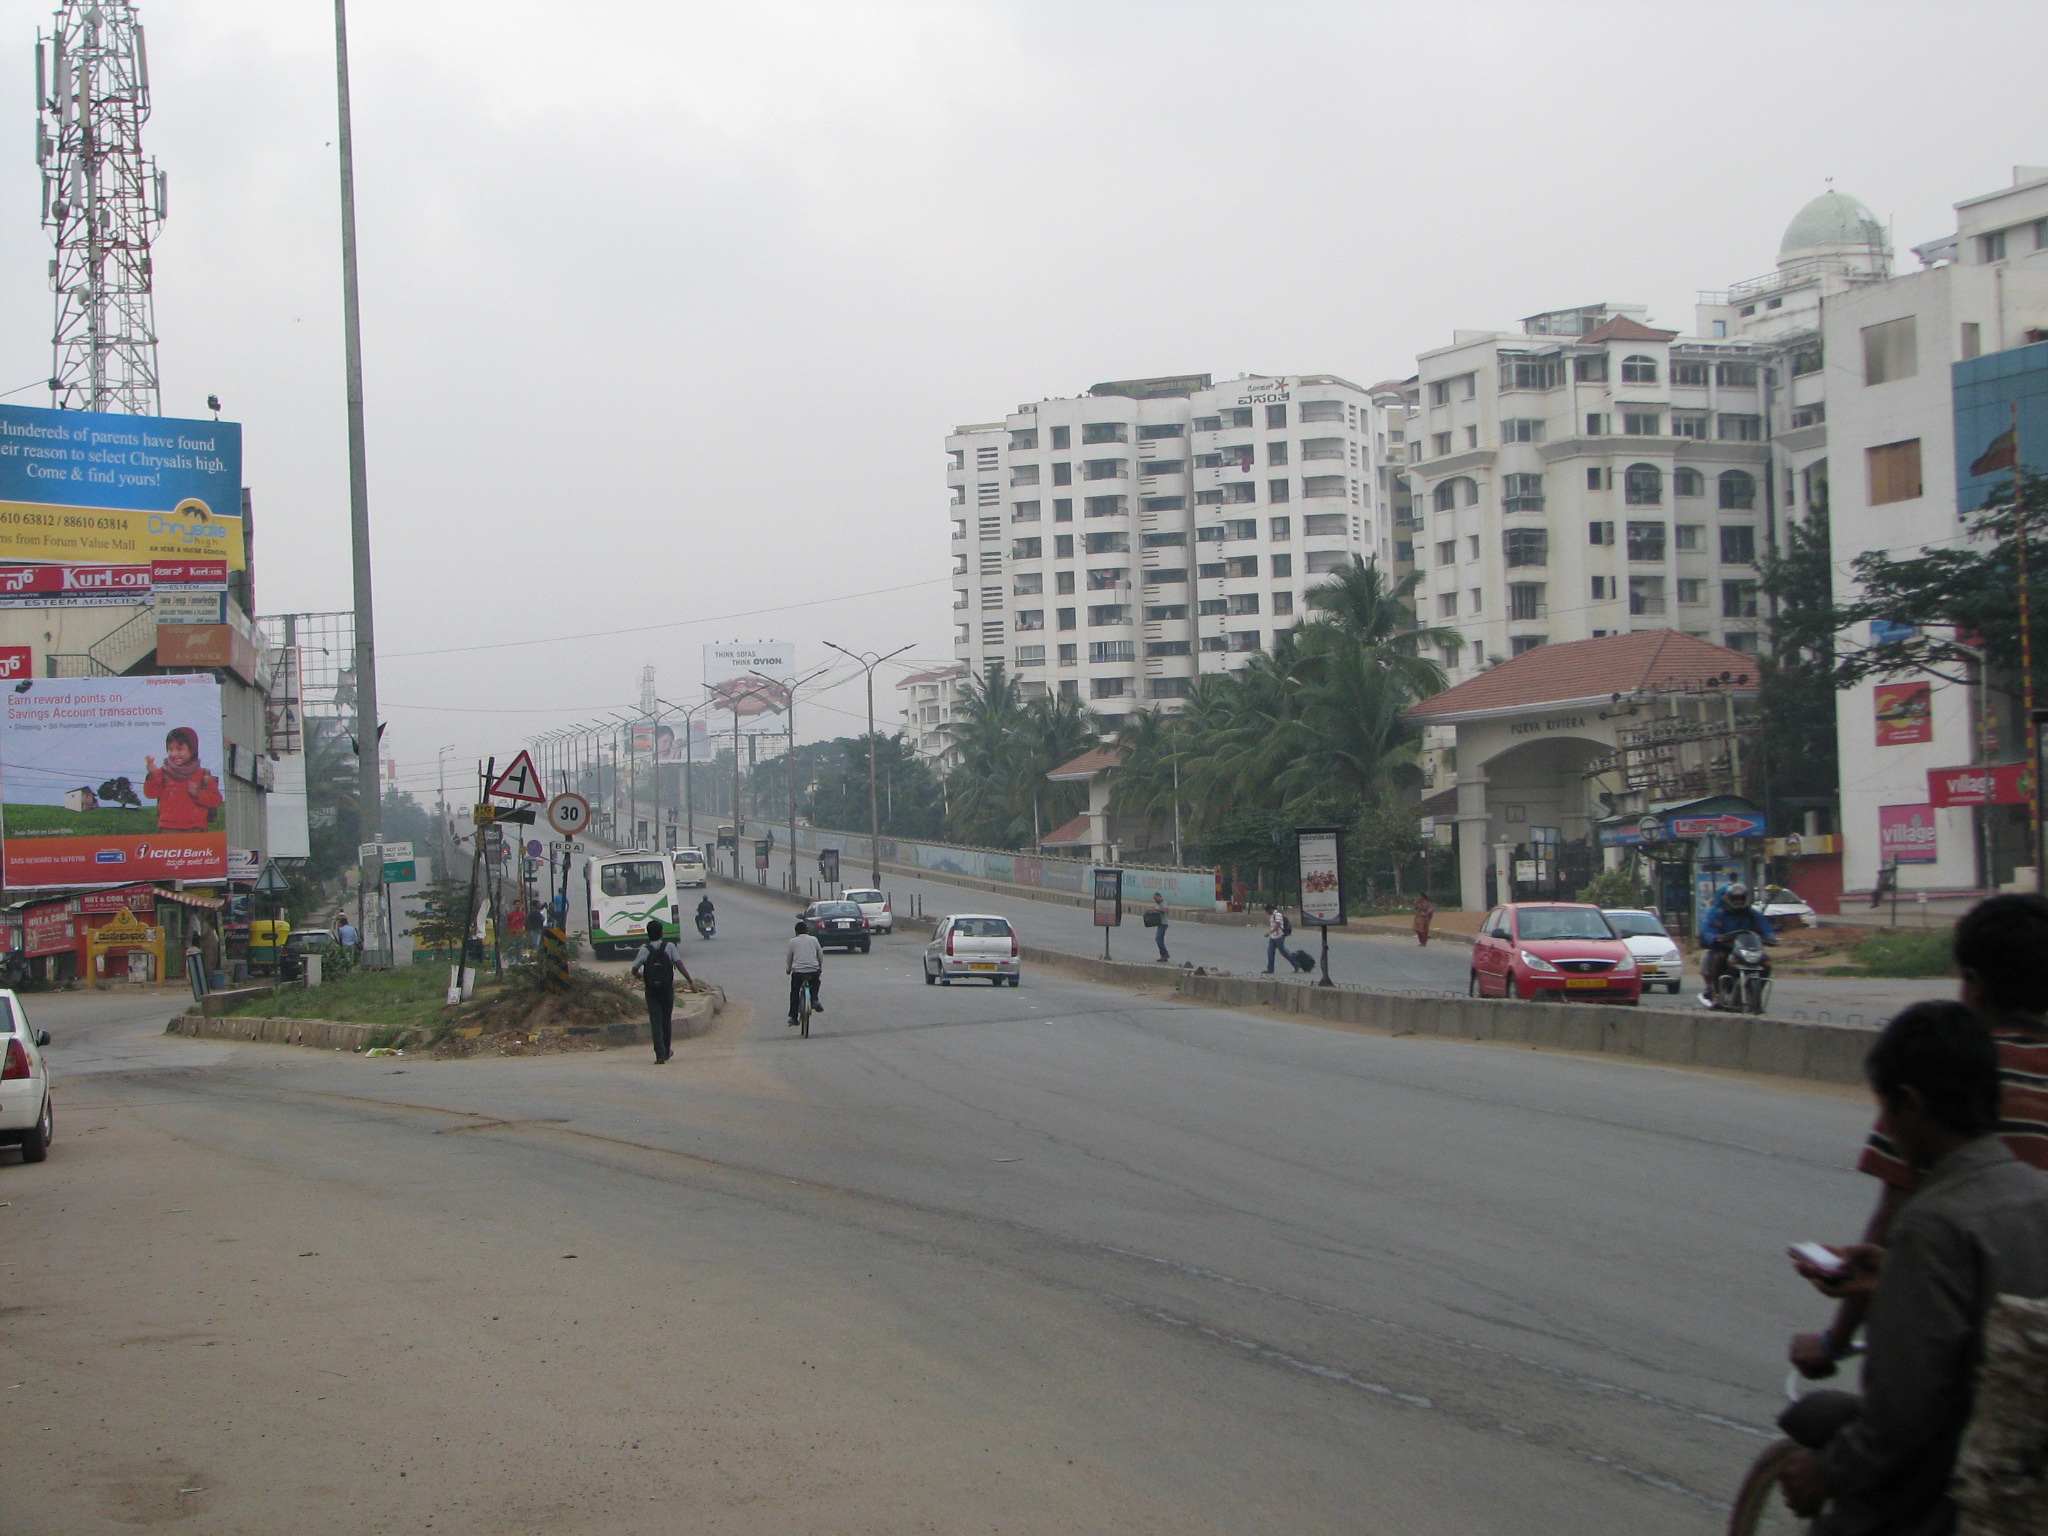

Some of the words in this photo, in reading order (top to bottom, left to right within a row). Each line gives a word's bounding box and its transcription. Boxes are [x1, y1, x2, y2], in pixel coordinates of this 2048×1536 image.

[0, 421, 69, 441] Hundereds
[74, 428, 89, 441] of
[92, 432, 138, 446] parents
[143, 433, 174, 448] have
[178, 436, 215, 451] found
[23, 446, 67, 459] reason
[71, 448, 84, 460] to
[89, 450, 126, 464] select
[130, 452, 192, 470] Chrysalis
[196, 456, 227, 474] high.
[26, 463, 66, 480] Come
[71, 467, 83, 481] &
[88, 468, 114, 483] find
[119, 473, 161, 487] yours!
[23, 514, 54, 526] 63812
[64, 516, 94, 528] 88610
[97, 518, 128, 529] 63814
[148, 516, 227, 543] Chrysalis
[16, 533, 40, 545] from
[43, 535, 76, 547] Forum
[80, 537, 109, 549] Value
[112, 539, 135, 550] Mall
[194, 538, 218, 548] high
[61, 567, 151, 590] Kurl-on
[189, 567, 223, 576] Kurl-on
[24, 599, 78, 607] ESTEEM
[8, 695, 31, 705] Earn
[34, 692, 71, 705] reward
[74, 693, 106, 707] points
[109, 694, 122, 703] on
[8, 708, 49, 720] Savings
[53, 707, 96, 718] Account
[100, 705, 163, 717] transactions
[1511, 722, 1541, 734] PURVA
[1946, 774, 1996, 793] village
[561, 807, 579, 821] 30
[1882, 824, 1937, 844] village
[26, 856, 53, 864] REWARD
[150, 849, 182, 858] ICICI
[184, 848, 214, 857] Bank
[51, 912, 68, 923] COOL
